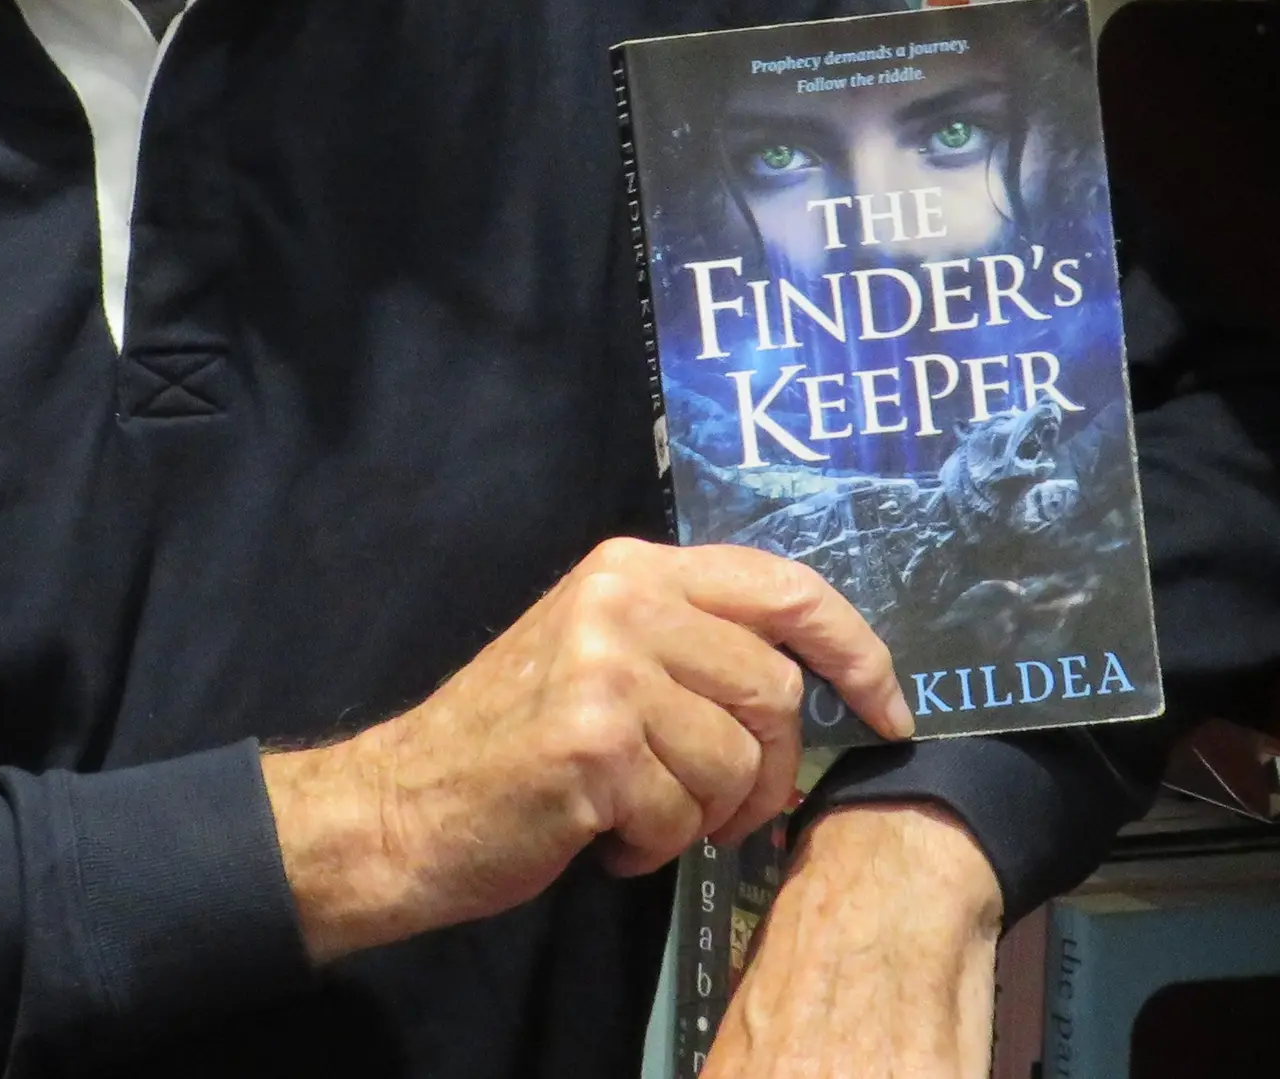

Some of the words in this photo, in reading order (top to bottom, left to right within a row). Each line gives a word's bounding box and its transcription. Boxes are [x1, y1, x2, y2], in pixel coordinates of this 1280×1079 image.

[751, 54, 821, 74] Prophecy
[823, 44, 892, 66] demands
[895, 46, 907, 58] a
[907, 37, 971, 60] journey.
[796, 76, 847, 94] Follow
[850, 73, 874, 88] the
[877, 66, 926, 85] riddle.
[807, 185, 948, 253] THE
[724, 351, 1086, 469] KEEPER
[910, 651, 1136, 716] KILDEA
